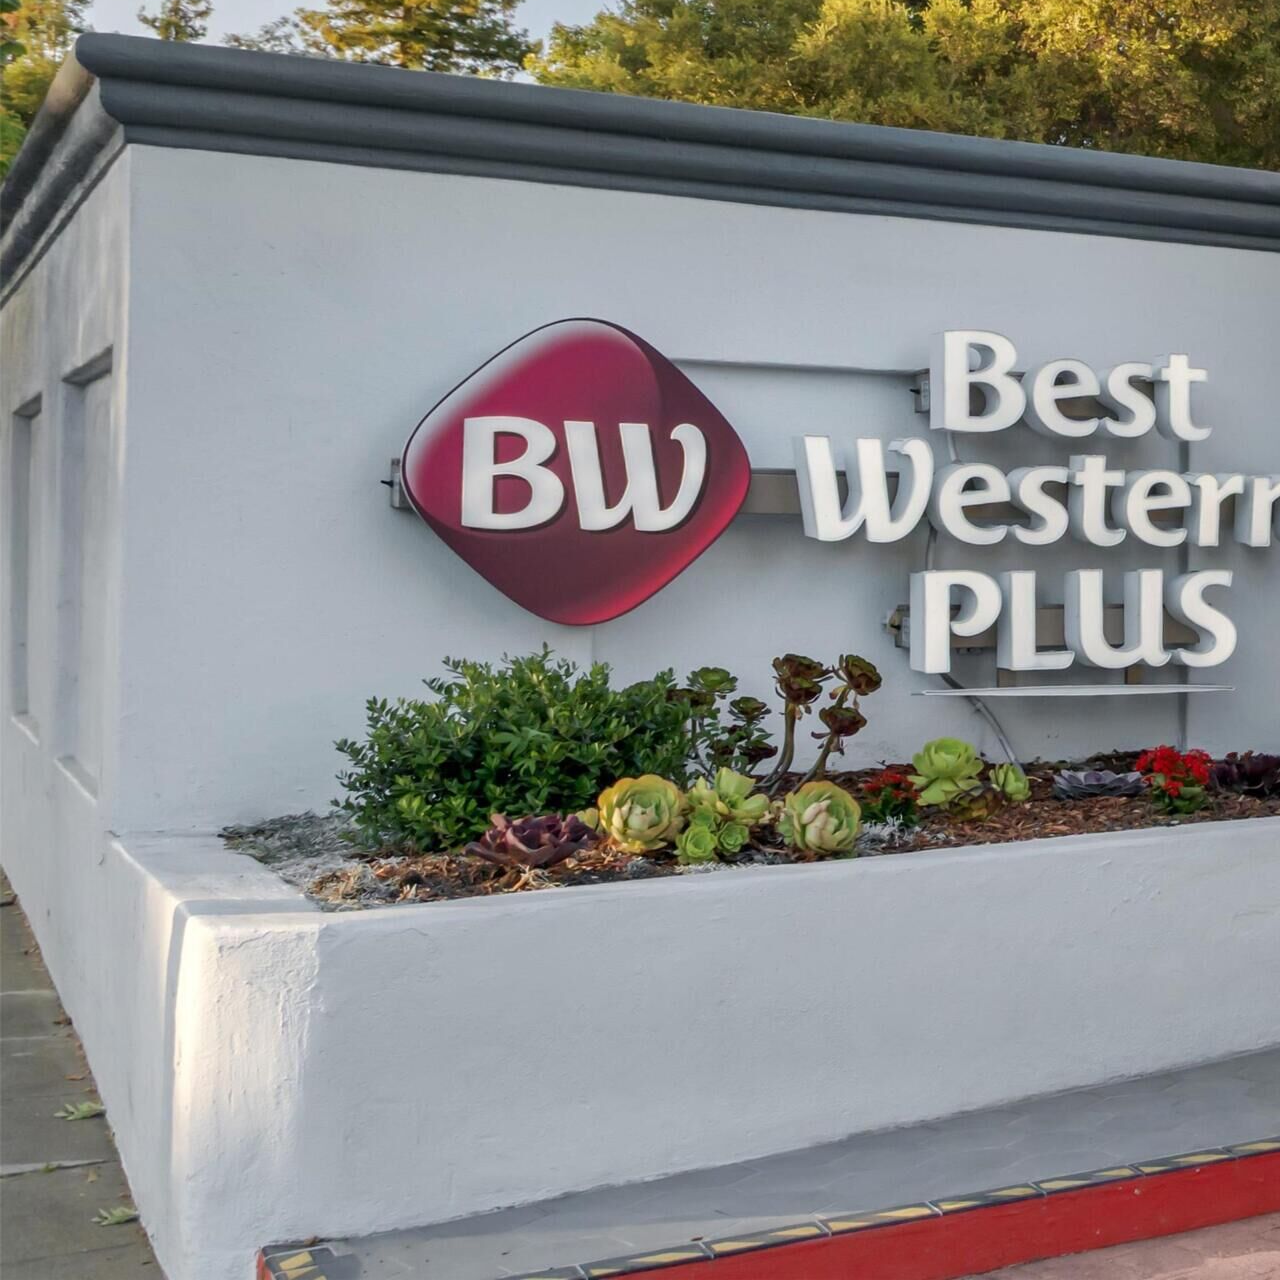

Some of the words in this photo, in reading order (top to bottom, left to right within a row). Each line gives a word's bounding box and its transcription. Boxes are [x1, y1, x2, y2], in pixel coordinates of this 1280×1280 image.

[929, 330, 1213, 441] Best
[460, 415, 709, 533] BW
[909, 568, 1239, 675] PLUS
